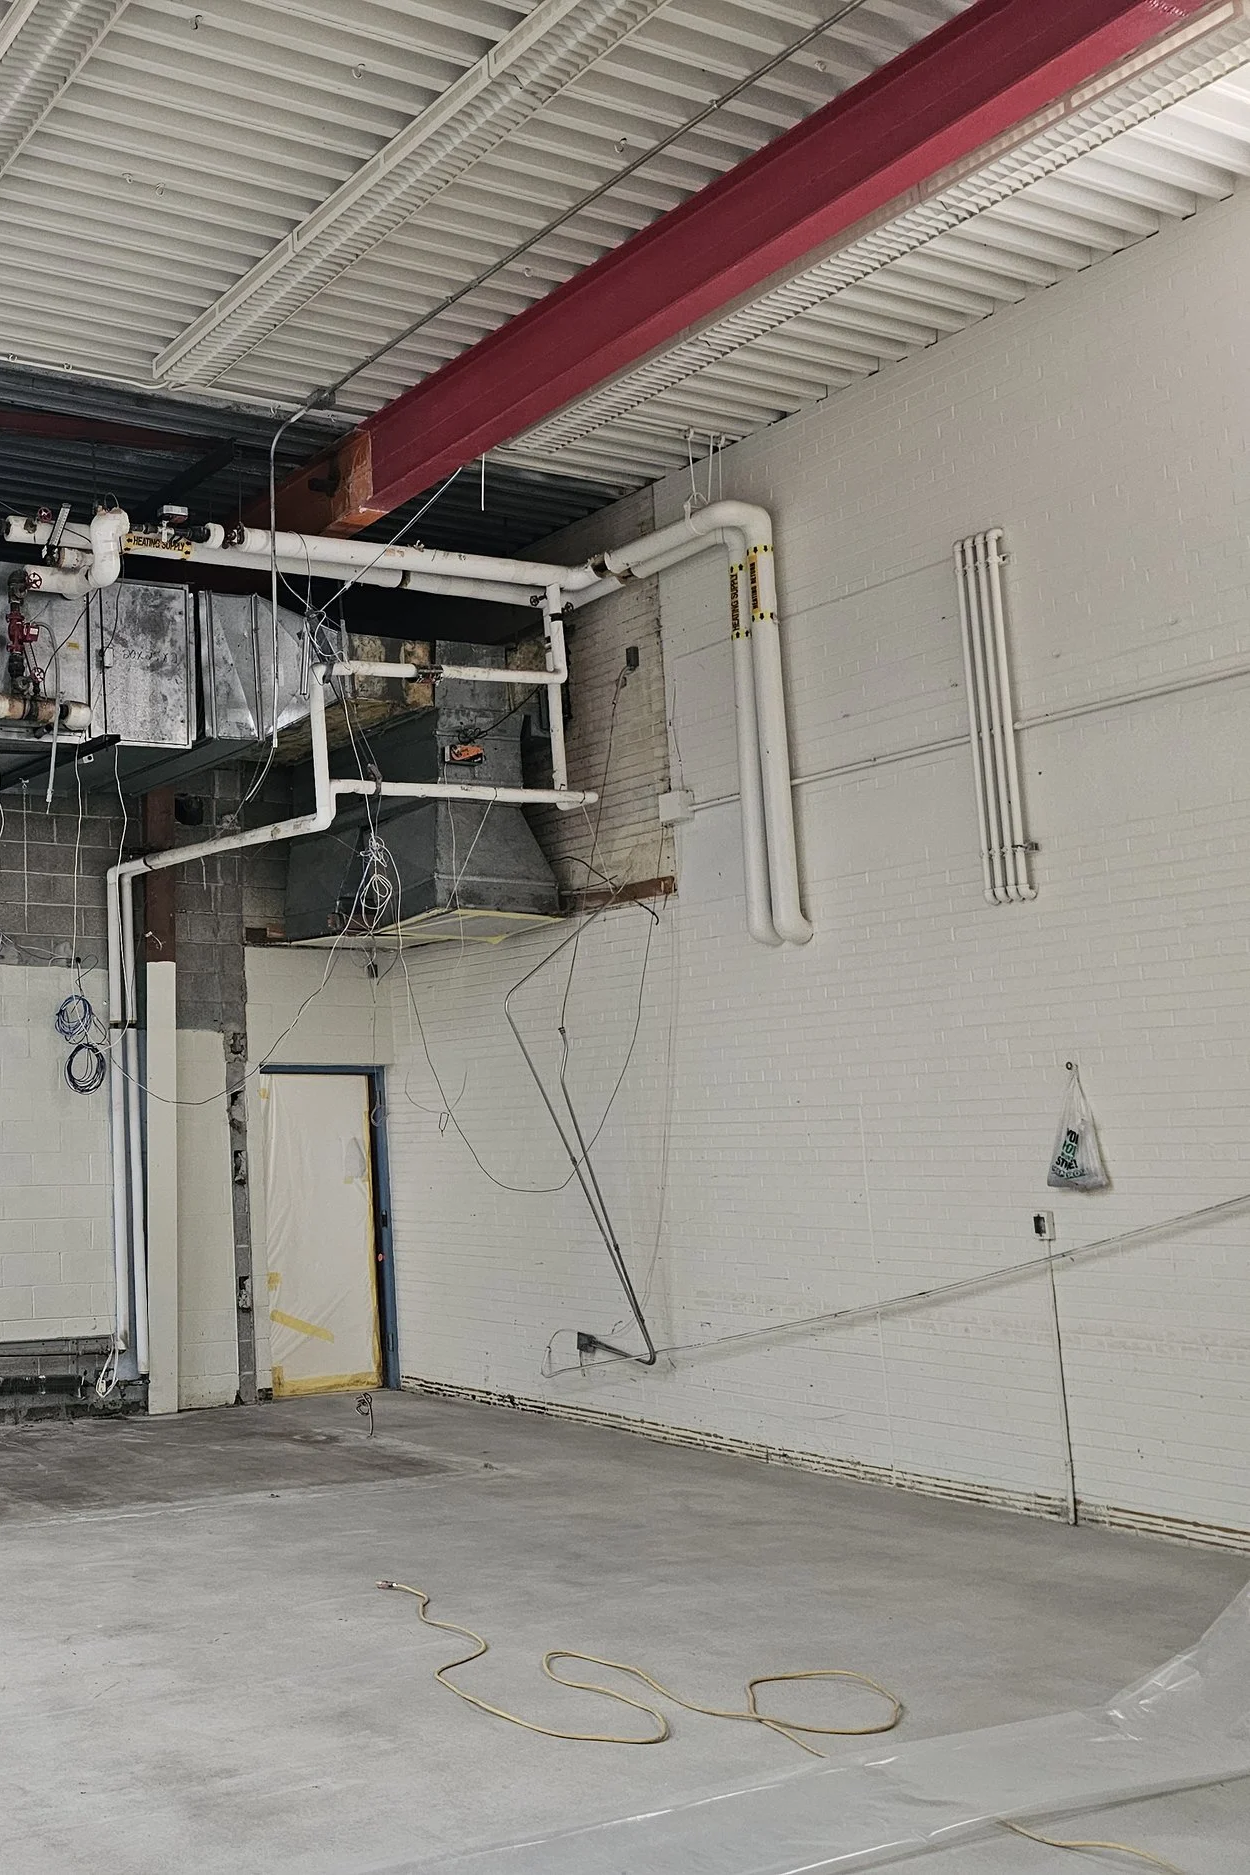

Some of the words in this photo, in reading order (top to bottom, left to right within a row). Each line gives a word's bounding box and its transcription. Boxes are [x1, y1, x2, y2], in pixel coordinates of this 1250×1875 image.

[133, 535, 161, 549] HEATING
[161, 540, 185, 552] SUPPLY
[730, 573, 738, 600] SUPPLY
[730, 600, 740, 632] HEATING
